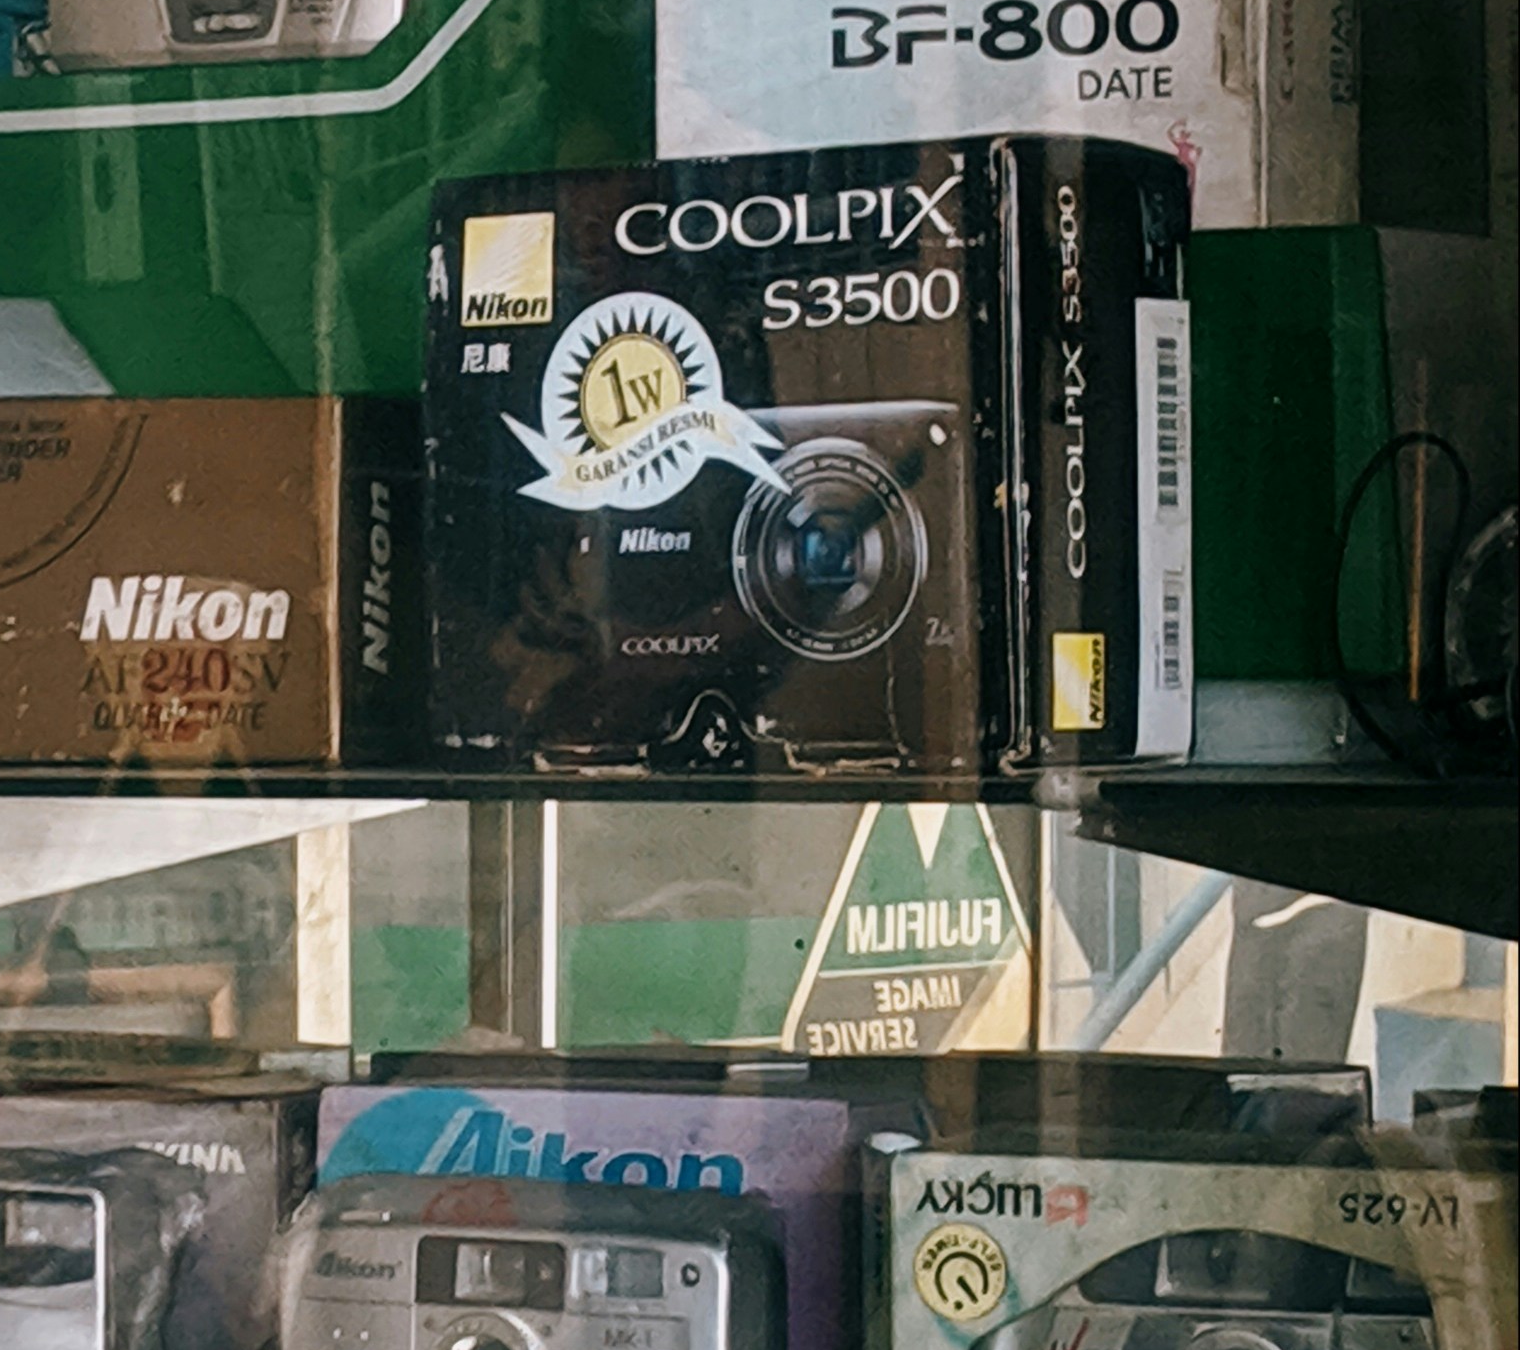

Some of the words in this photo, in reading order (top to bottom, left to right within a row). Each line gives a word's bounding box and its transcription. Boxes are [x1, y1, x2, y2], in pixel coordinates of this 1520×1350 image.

[1077, 66, 1173, 101] DATE
[614, 176, 962, 256] COOLPIX
[1056, 185, 1082, 323] S3500
[464, 294, 548, 323] Nikon
[762, 267, 961, 332] S3500
[575, 436, 654, 483] GARANSI
[658, 409, 717, 445] RESMI
[1060, 341, 1086, 580] COOLPIX
[619, 528, 692, 554] Nikon
[79, 574, 292, 643] Nikon
[360, 481, 391, 675] Nikon
[621, 632, 721, 657] COOLPIX
[1088, 637, 1104, 723] Nikon
[914, 1170, 1042, 1218] LUCKY
[1338, 1191, 1460, 1227] LV-625
